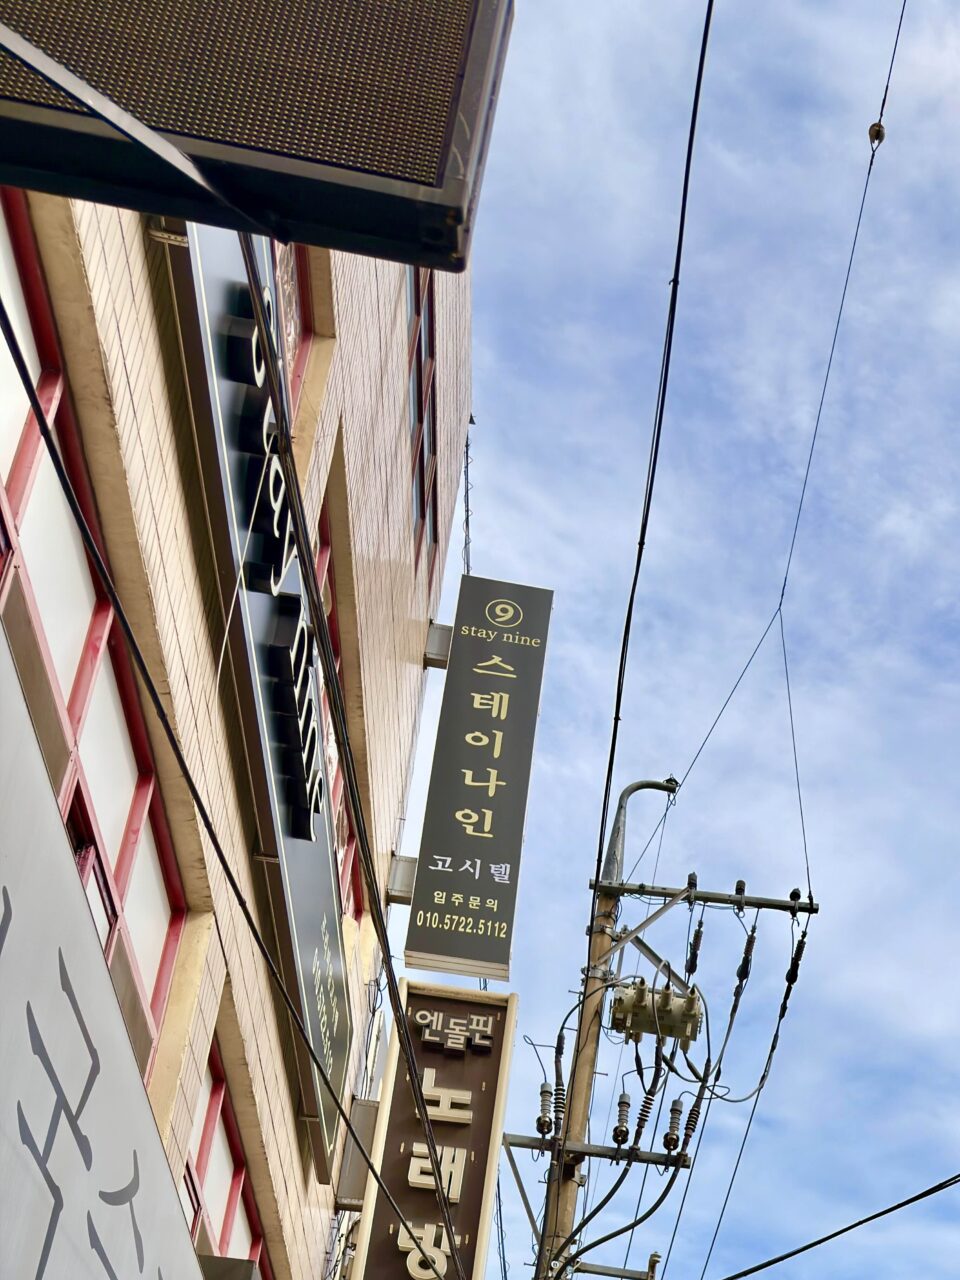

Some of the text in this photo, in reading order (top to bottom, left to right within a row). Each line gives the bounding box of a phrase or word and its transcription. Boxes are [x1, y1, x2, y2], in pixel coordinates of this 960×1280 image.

[461, 624, 541, 648] stay nine
[455, 654, 517, 839] 스테이나인
[428, 854, 511, 884] 고시텔
[433, 890, 499, 912] 입주문의
[416, 910, 508, 939] 010.5722.5112
[415, 1009, 494, 1049] 엔돌핀
